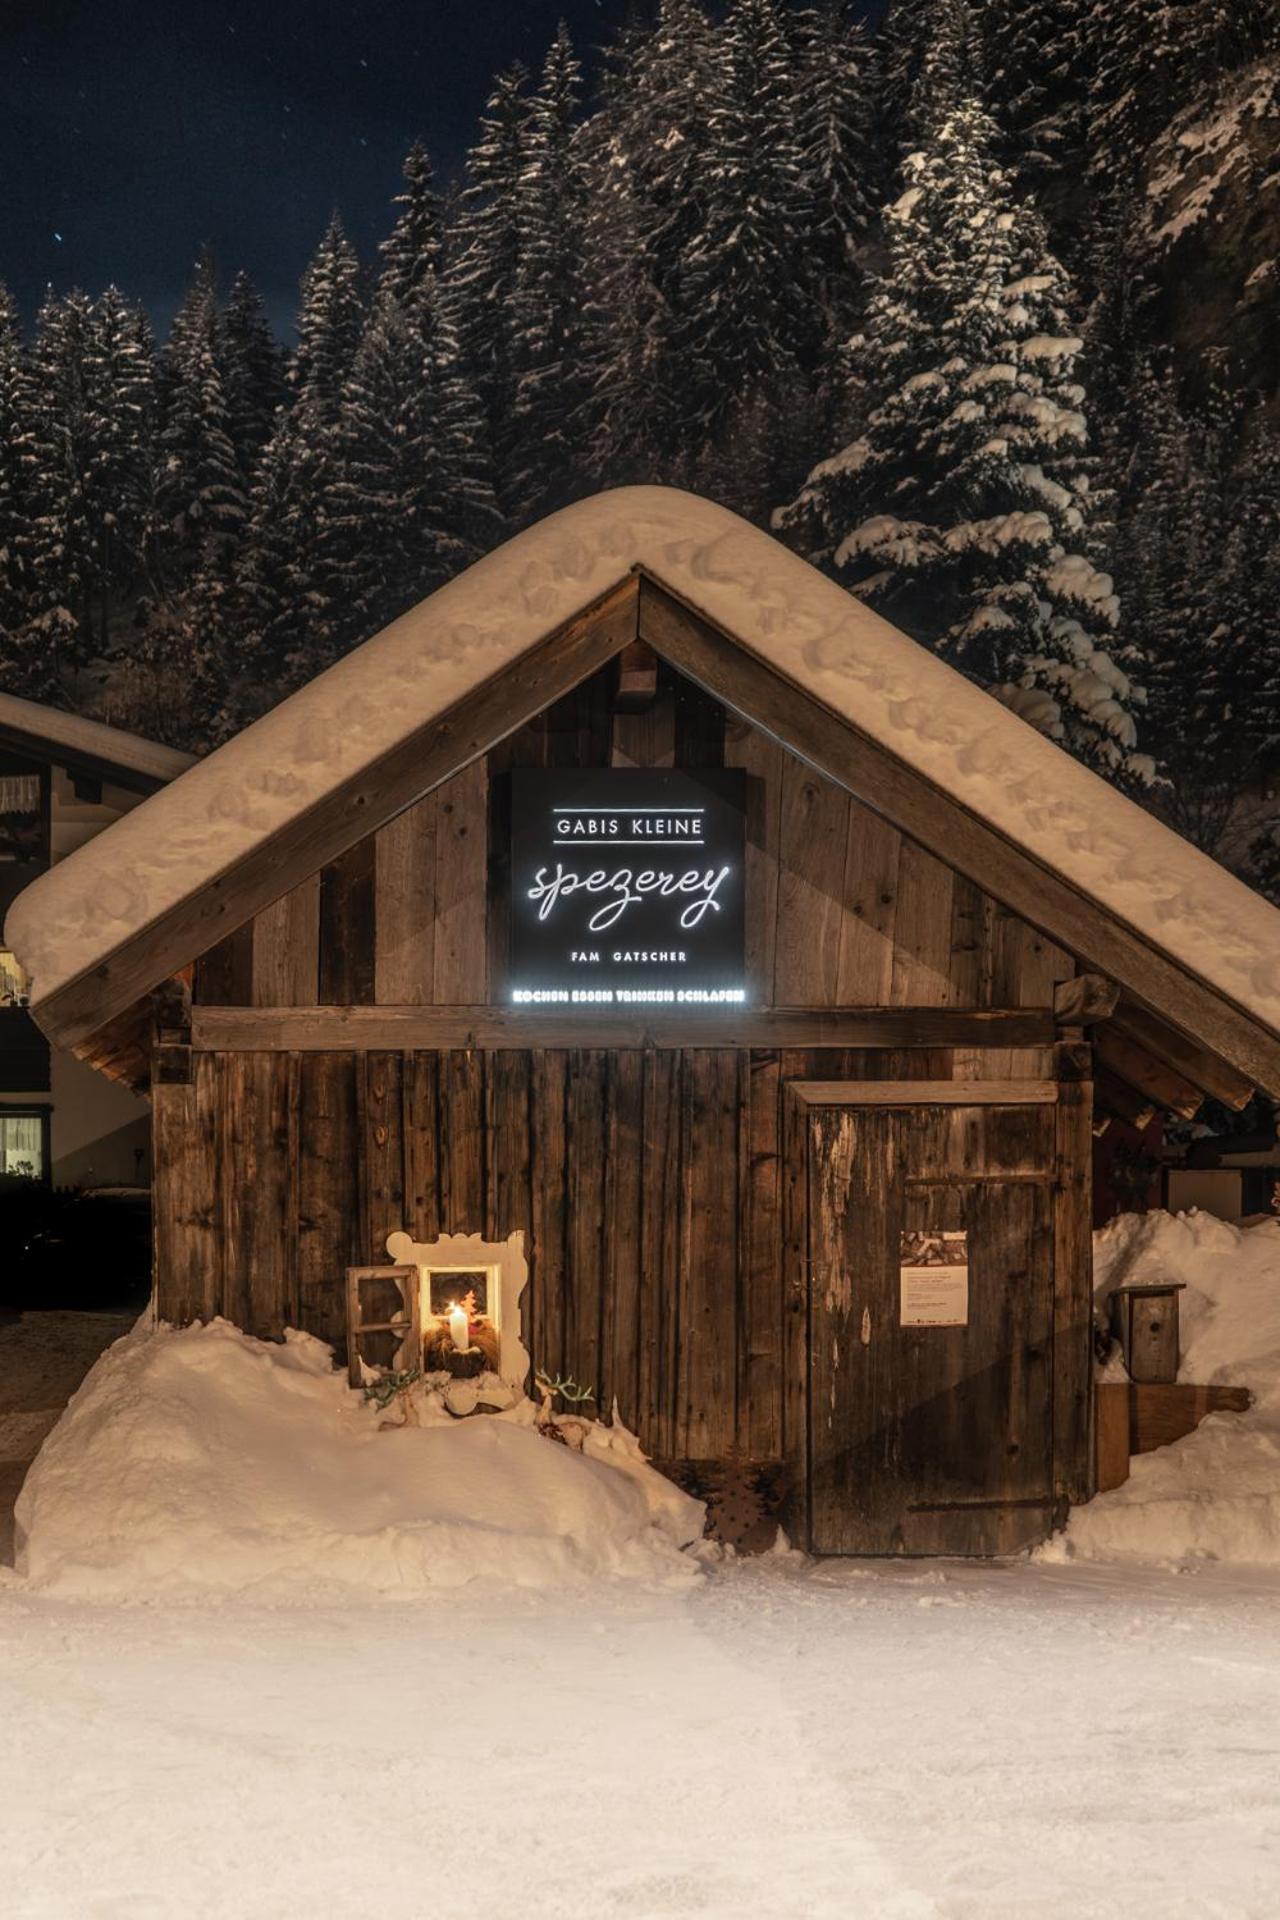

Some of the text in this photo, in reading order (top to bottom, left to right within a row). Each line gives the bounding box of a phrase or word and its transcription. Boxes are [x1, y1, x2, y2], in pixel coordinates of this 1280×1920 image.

[557, 819, 702, 834] GABIS KLEINE
[571, 951, 687, 962] FAM GATSCHER
[513, 990, 569, 1002] KOCHEN
